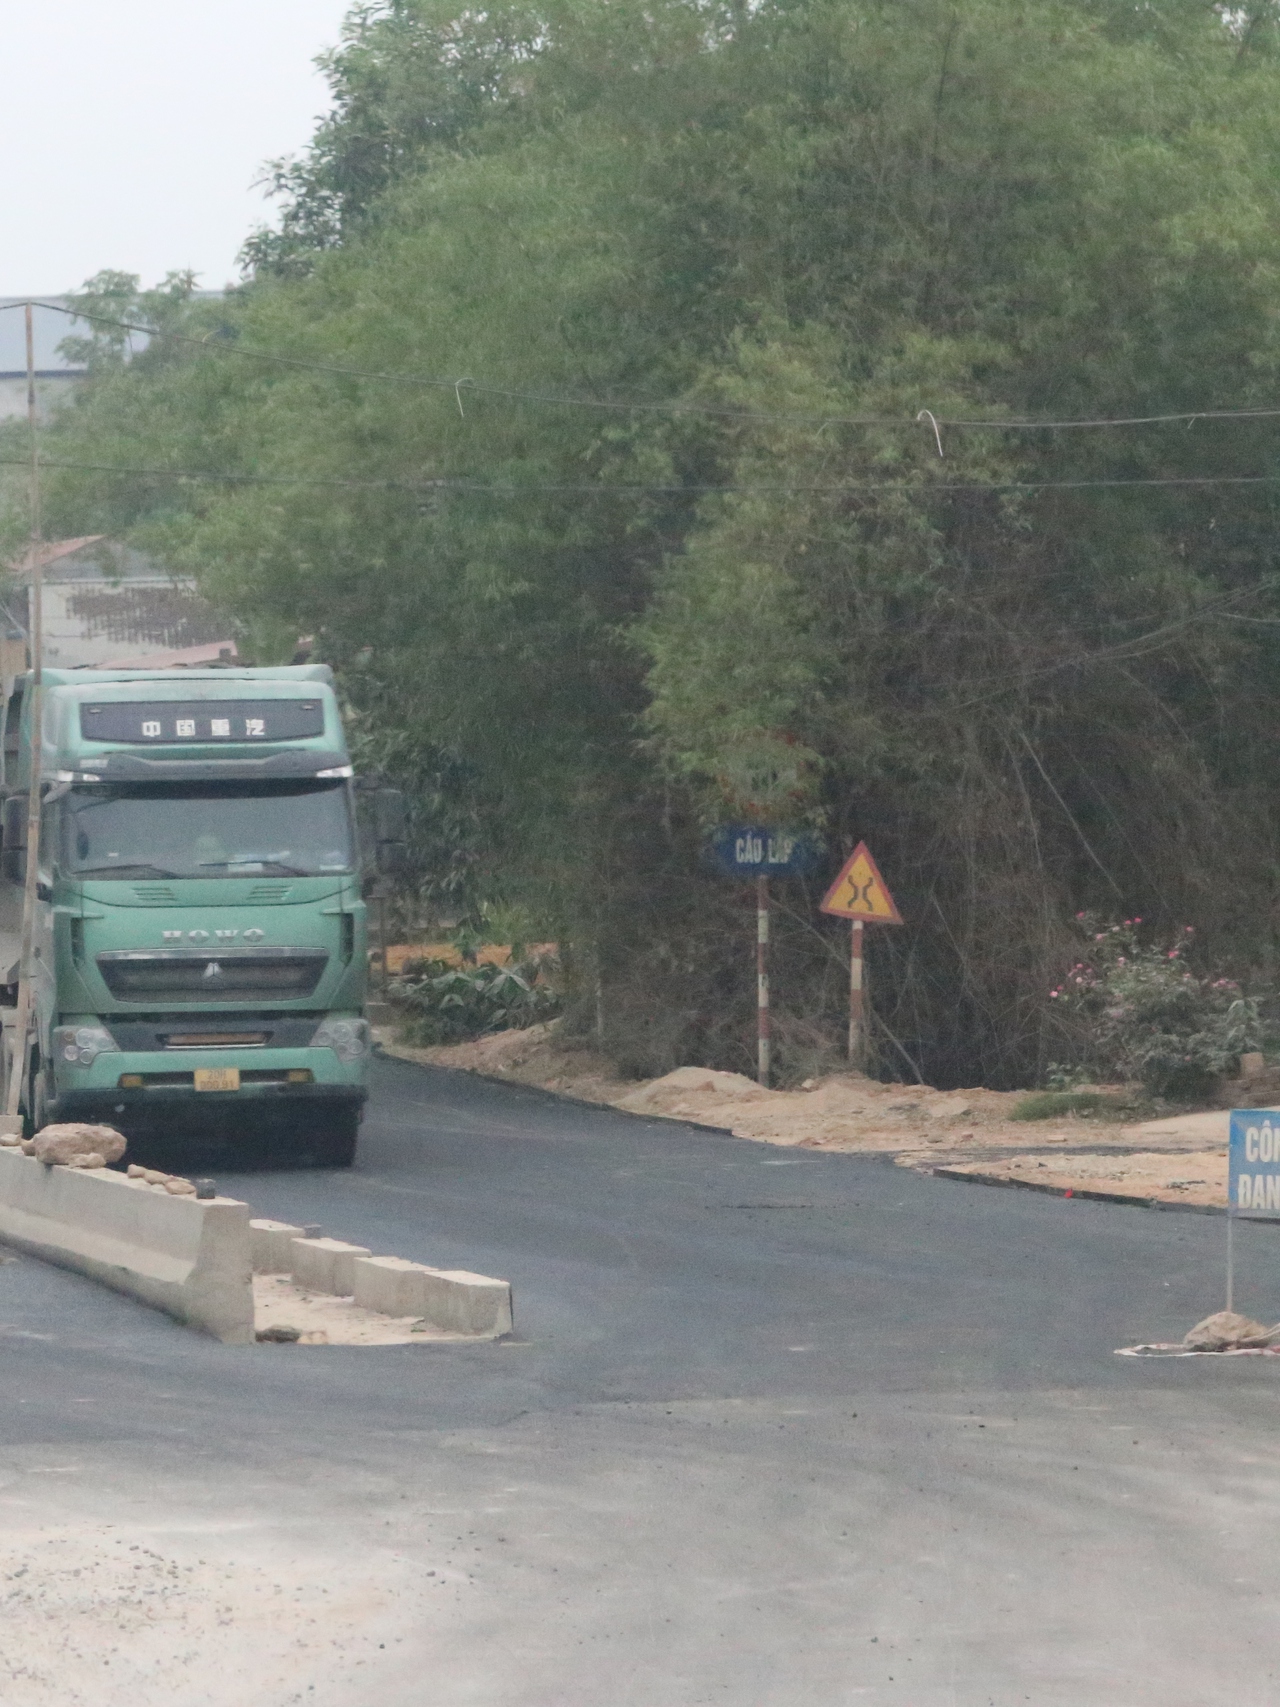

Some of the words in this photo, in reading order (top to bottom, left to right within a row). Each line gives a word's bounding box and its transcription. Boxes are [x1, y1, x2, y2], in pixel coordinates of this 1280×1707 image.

[142, 719, 265, 737] 中国重汽
[161, 928, 265, 942] HOWO
